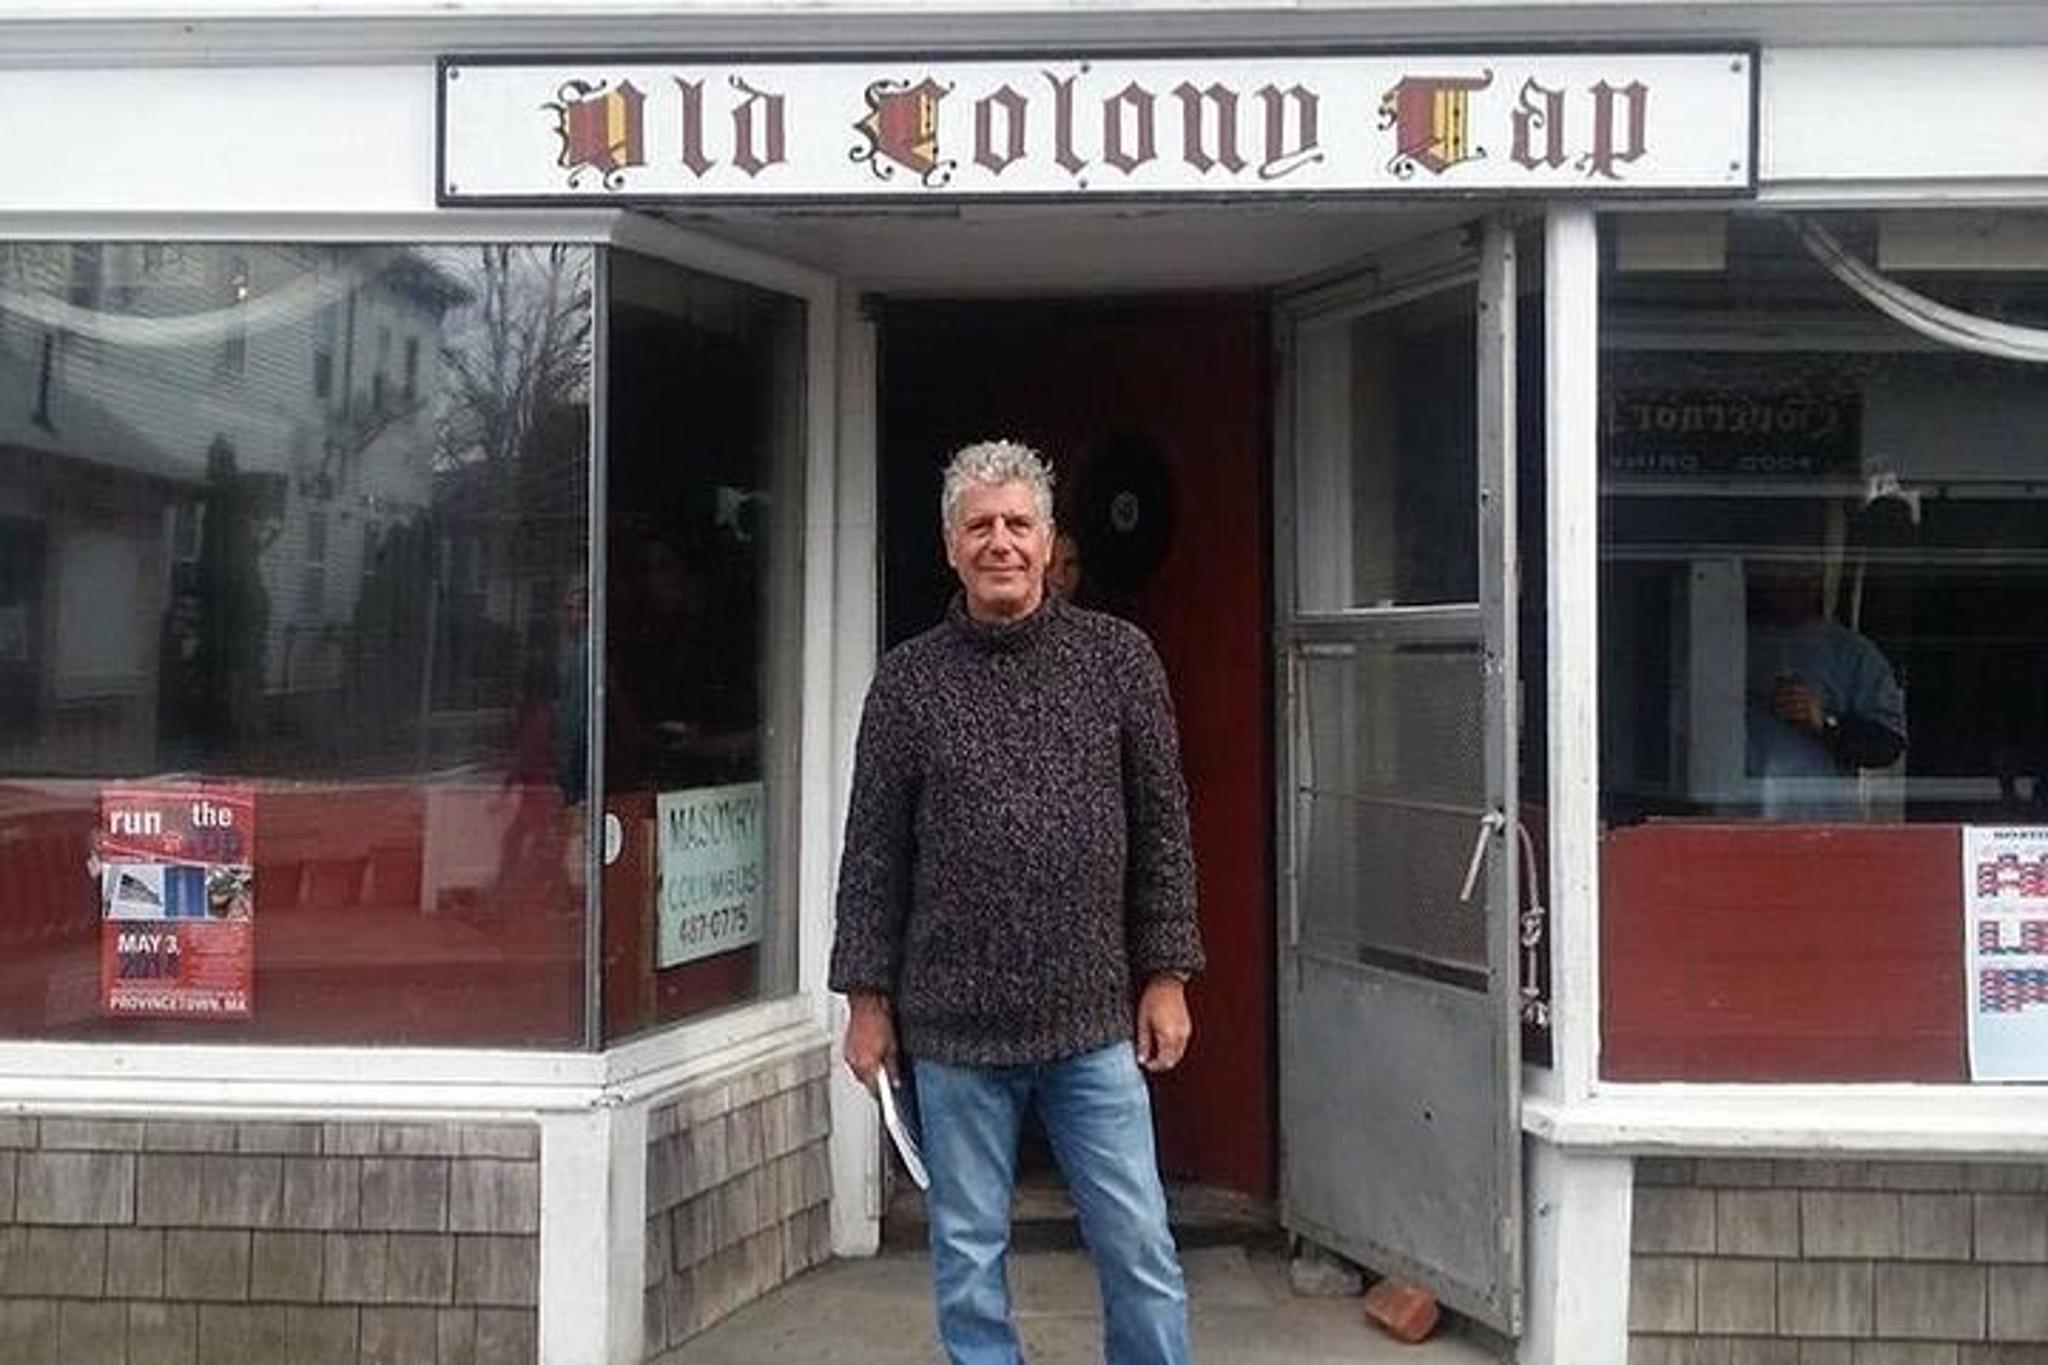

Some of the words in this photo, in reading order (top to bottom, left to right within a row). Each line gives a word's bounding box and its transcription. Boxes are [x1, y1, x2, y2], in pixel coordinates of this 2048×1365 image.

[540, 75, 786, 190] Old
[849, 69, 1324, 189] Colony
[1377, 68, 1649, 180] Tap
[110, 810, 161, 834] run
[192, 801, 233, 827] the
[117, 934, 161, 954] MAY
